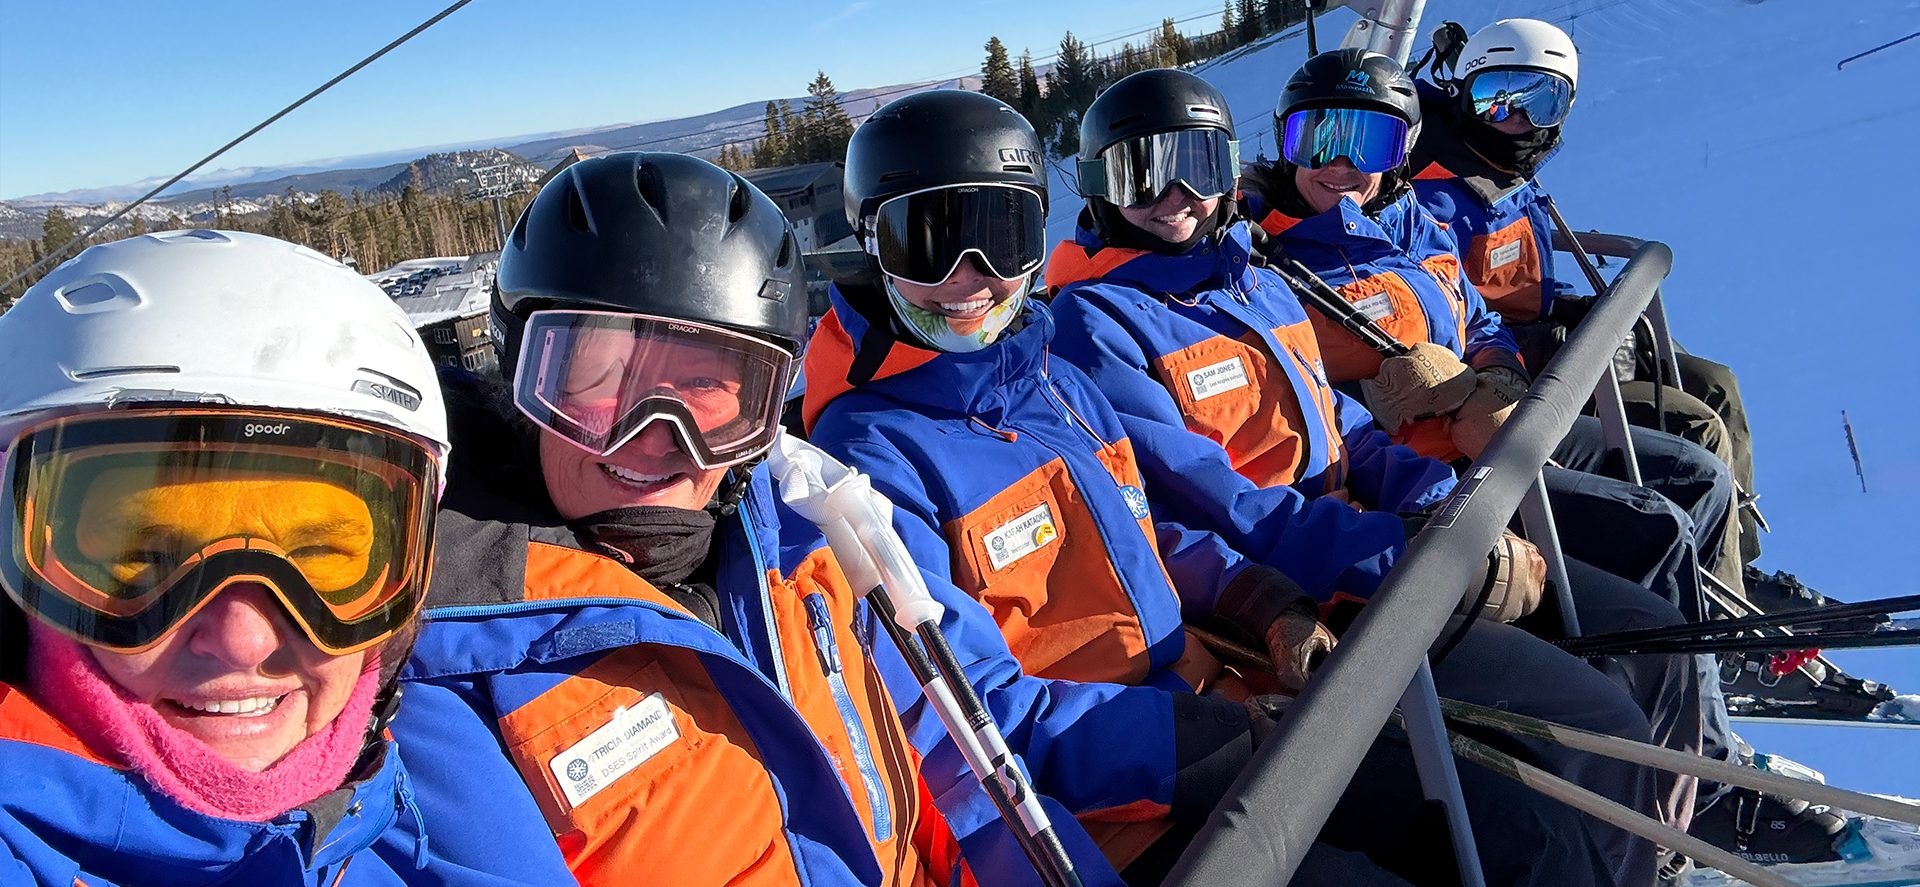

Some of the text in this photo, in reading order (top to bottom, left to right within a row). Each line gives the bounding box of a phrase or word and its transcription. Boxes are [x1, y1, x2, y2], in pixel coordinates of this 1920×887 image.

[998, 147, 1041, 165] GIRO
[668, 322, 700, 335] DRAGON
[1203, 363, 1236, 379] SAM JONES
[370, 382, 412, 409] SMITH
[244, 423, 291, 437] goodr
[601, 727, 673, 778] DSES Spirit Award
